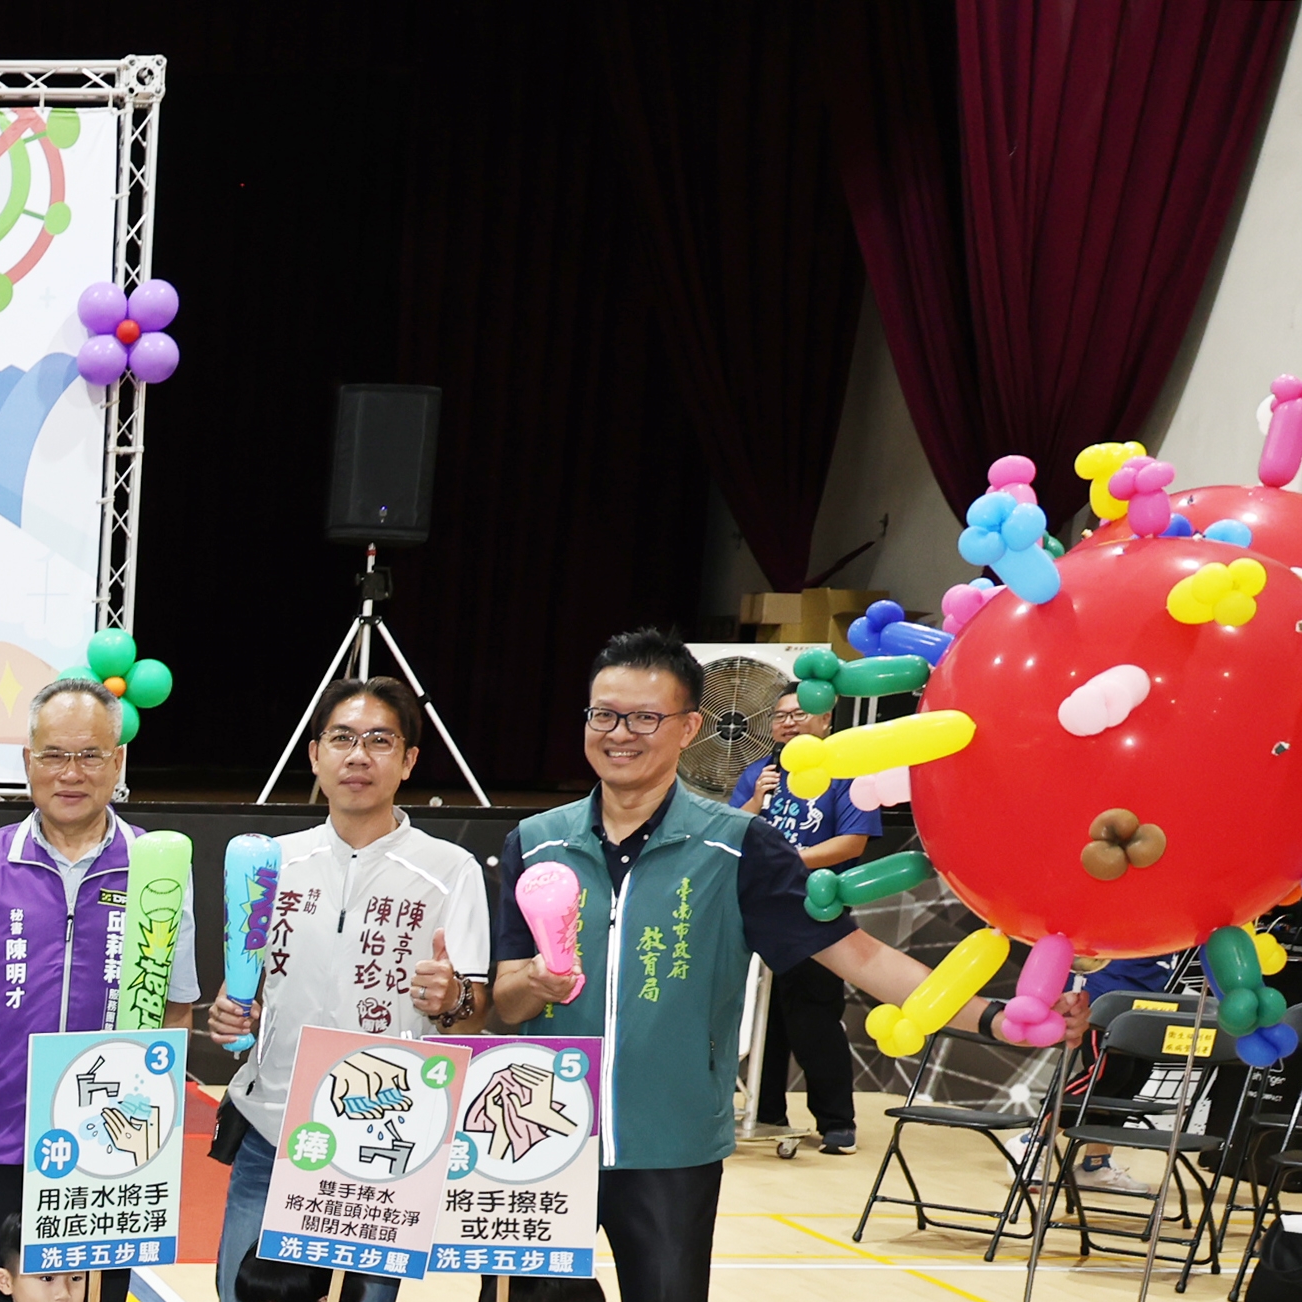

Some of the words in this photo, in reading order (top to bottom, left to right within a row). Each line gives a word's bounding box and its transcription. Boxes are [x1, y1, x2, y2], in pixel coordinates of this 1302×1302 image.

[10, 908, 25, 936] 秘書
[270, 889, 304, 977] 李介文
[353, 895, 395, 990] 陳怡珍
[385, 898, 427, 995] 陳亭妃
[5, 938, 28, 1009] 陳明才
[636, 926, 667, 1003] 教育局
[150, 1046, 170, 1071] 3
[425, 1060, 448, 1085] 4
[560, 1053, 582, 1076] 5
[40, 1136, 72, 1171] 沖
[294, 1129, 330, 1164] 捧
[36, 1181, 169, 1212] 用清水將手
[317, 1179, 396, 1205] 雙手捧水
[445, 1189, 570, 1216] 將手擦乾
[35, 1208, 168, 1239] 徹底沖乾淨
[284, 1193, 421, 1228] 將水龍頭沖乾淨
[301, 1214, 398, 1244] 關閉水龍頭
[460, 1217, 553, 1242] 或烘乾
[40, 1241, 161, 1269] 洗手五步驟
[277, 1235, 409, 1275] 洗手五步驟
[435, 1247, 575, 1273] 洗手五步驟
